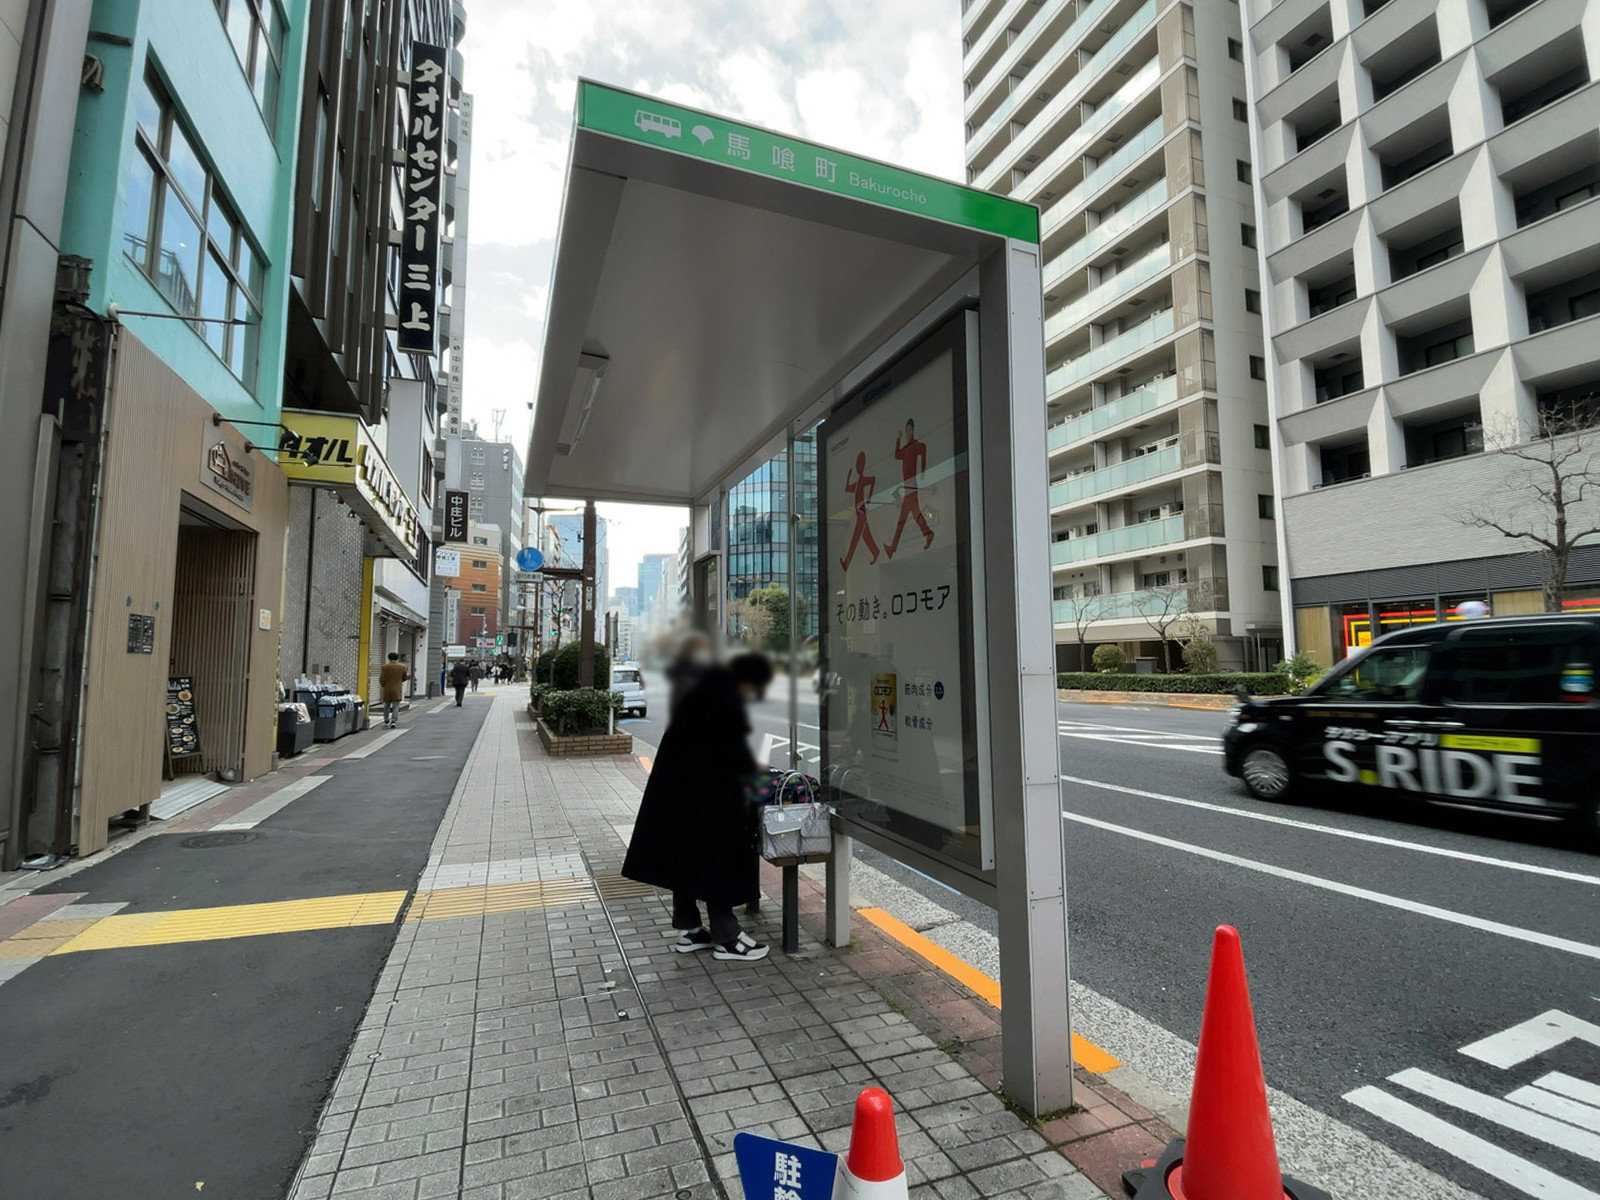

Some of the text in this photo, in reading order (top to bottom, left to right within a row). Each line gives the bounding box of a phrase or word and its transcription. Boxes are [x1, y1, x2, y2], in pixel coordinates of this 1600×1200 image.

[727, 132, 837, 183] 馬喰町
[450, 496, 463, 538] 中庄ビル
